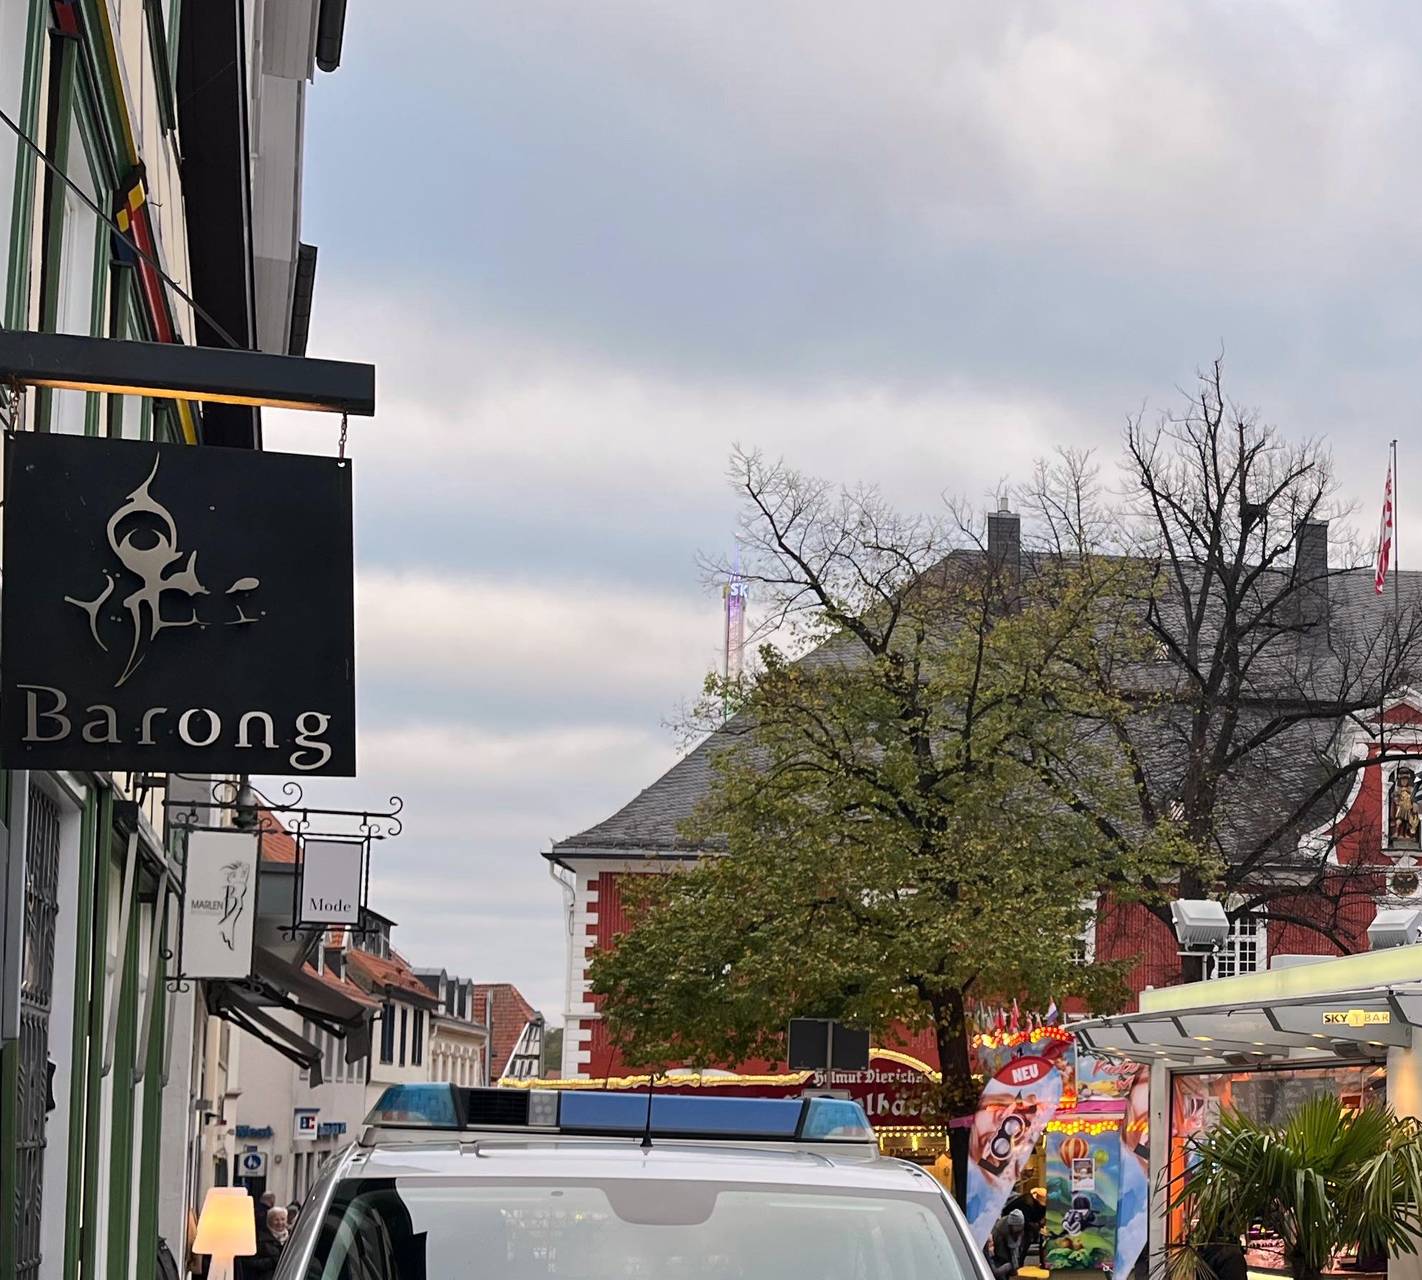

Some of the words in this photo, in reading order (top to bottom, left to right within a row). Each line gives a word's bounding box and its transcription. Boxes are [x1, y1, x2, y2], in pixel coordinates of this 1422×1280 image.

[16, 684, 332, 771] Barong
[191, 900, 224, 911] MARLEN
[310, 897, 352, 913] Mode
[1324, 1014, 1348, 1023] SKY
[1364, 1013, 1389, 1022] BAR
[1011, 1063, 1039, 1084] NEU
